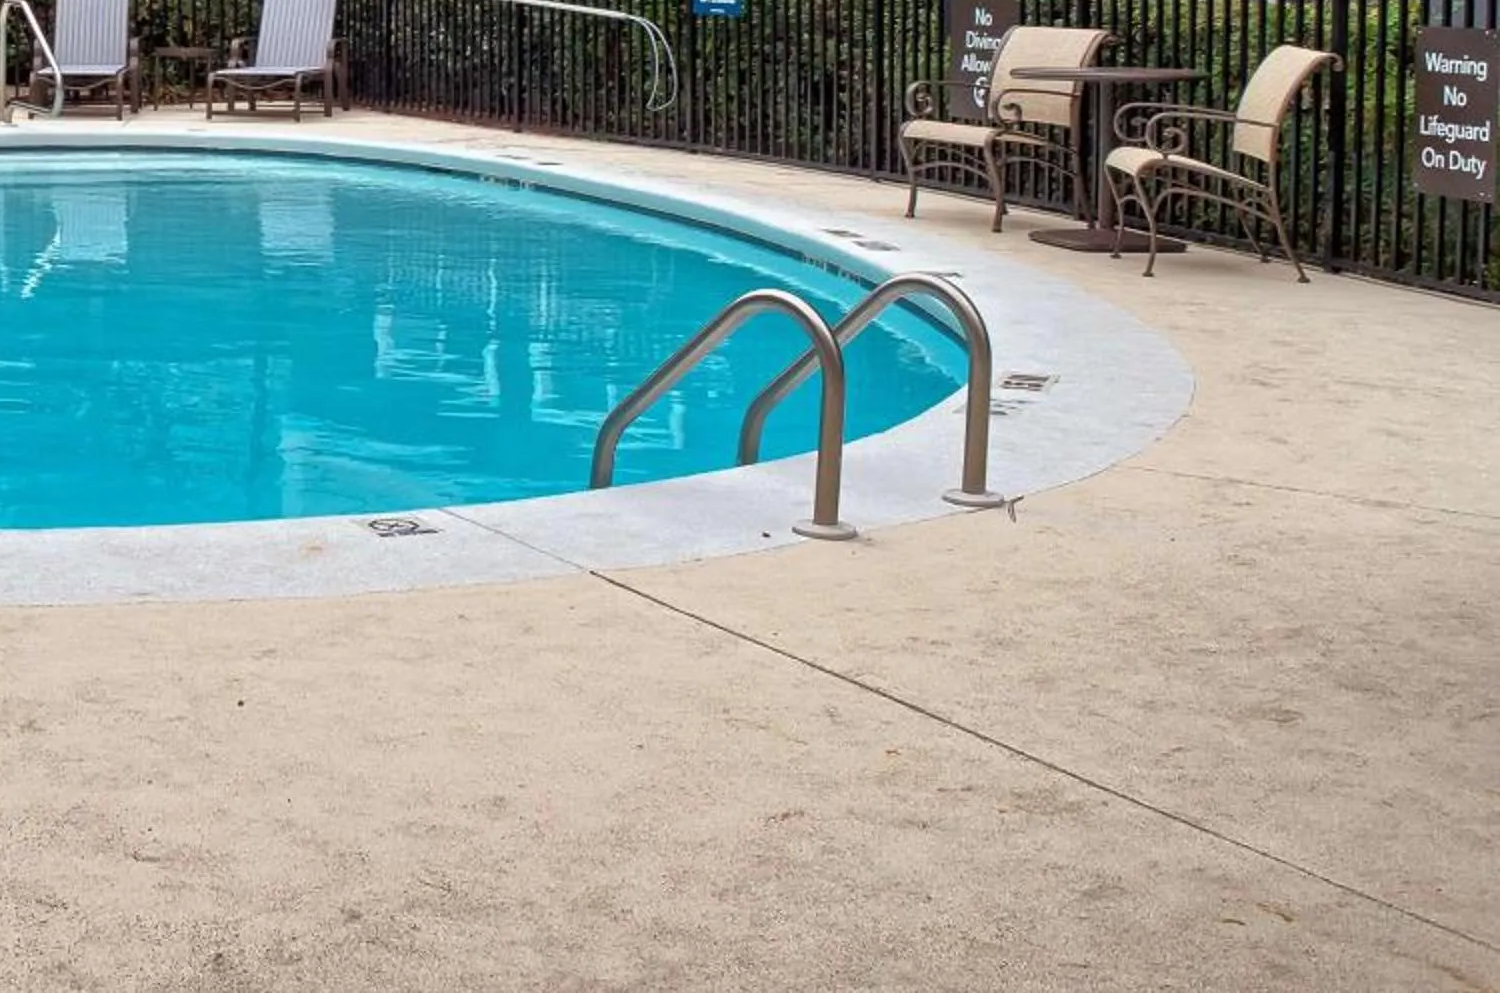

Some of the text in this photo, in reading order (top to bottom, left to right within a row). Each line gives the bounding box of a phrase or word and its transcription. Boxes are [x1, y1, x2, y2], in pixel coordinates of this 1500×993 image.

[975, 7, 993, 26] No
[961, 53, 991, 73] Allow
[1425, 51, 1488, 82] Warning
[1443, 85, 1467, 107] No
[1419, 114, 1491, 143] Lifeguard
[1421, 147, 1487, 180] On Duty
